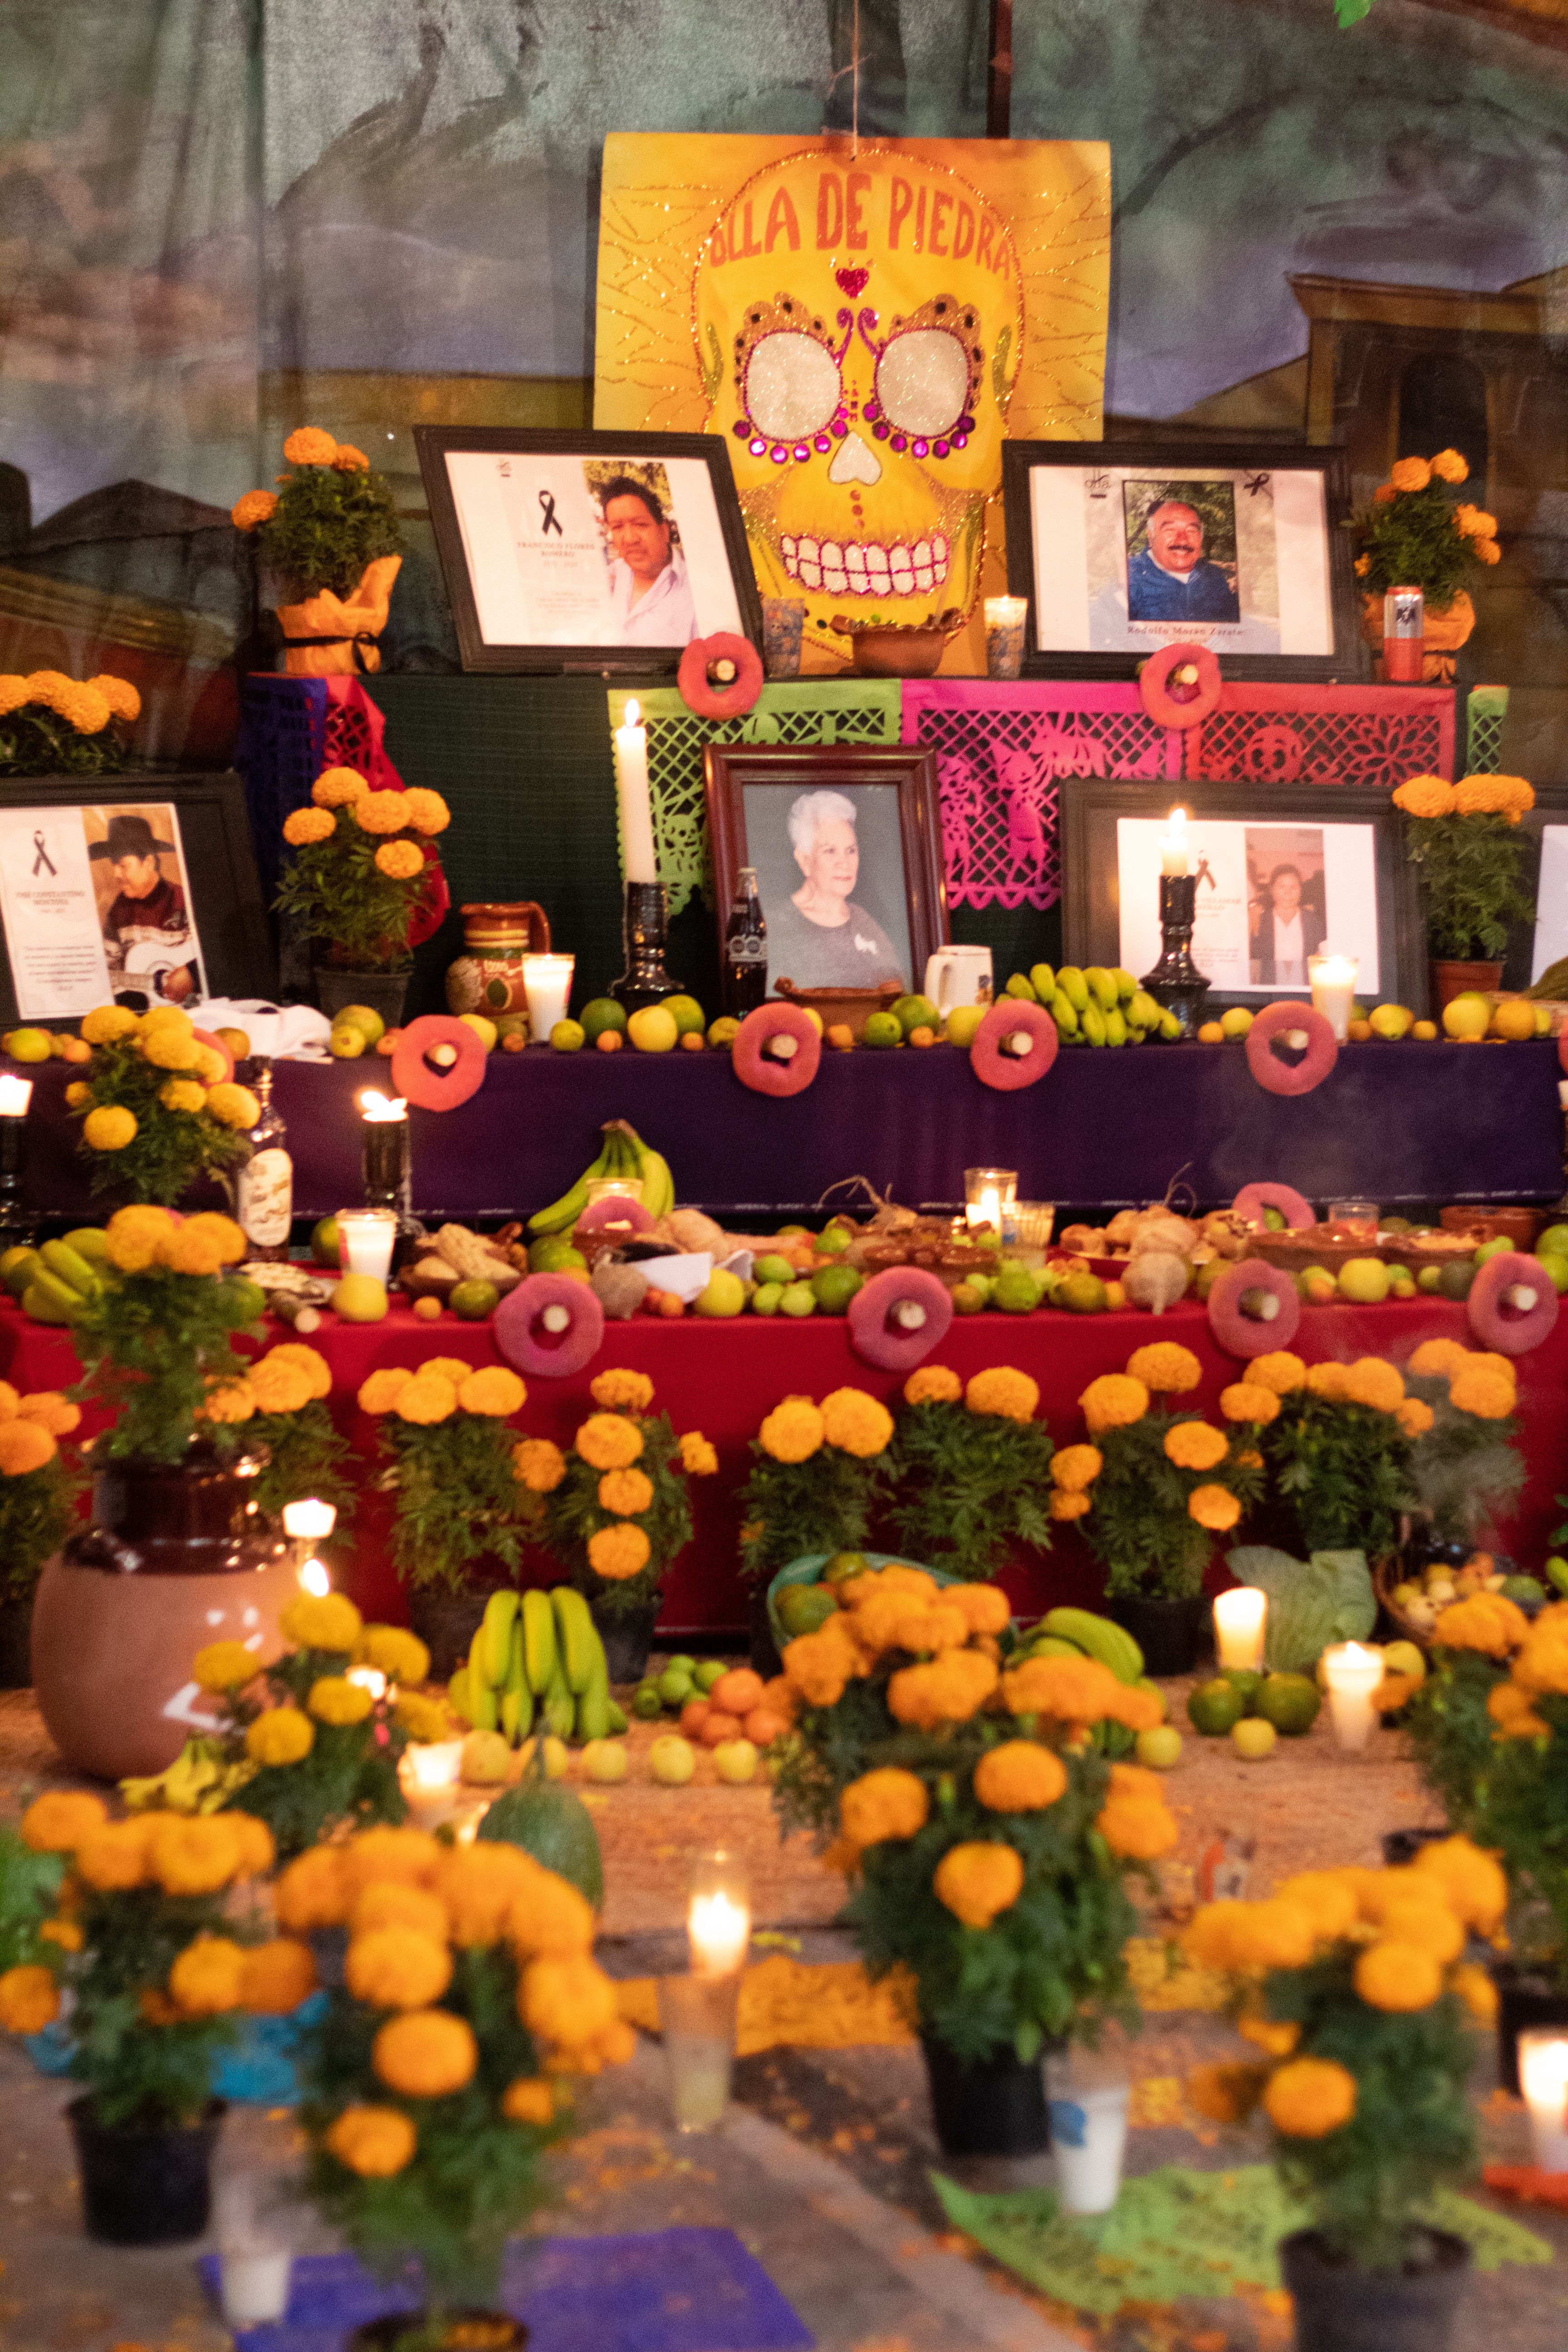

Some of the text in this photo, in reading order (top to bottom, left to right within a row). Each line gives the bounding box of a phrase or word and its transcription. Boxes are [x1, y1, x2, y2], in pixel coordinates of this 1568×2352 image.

[709, 172, 1010, 280] OLLA DE PIEDRA
